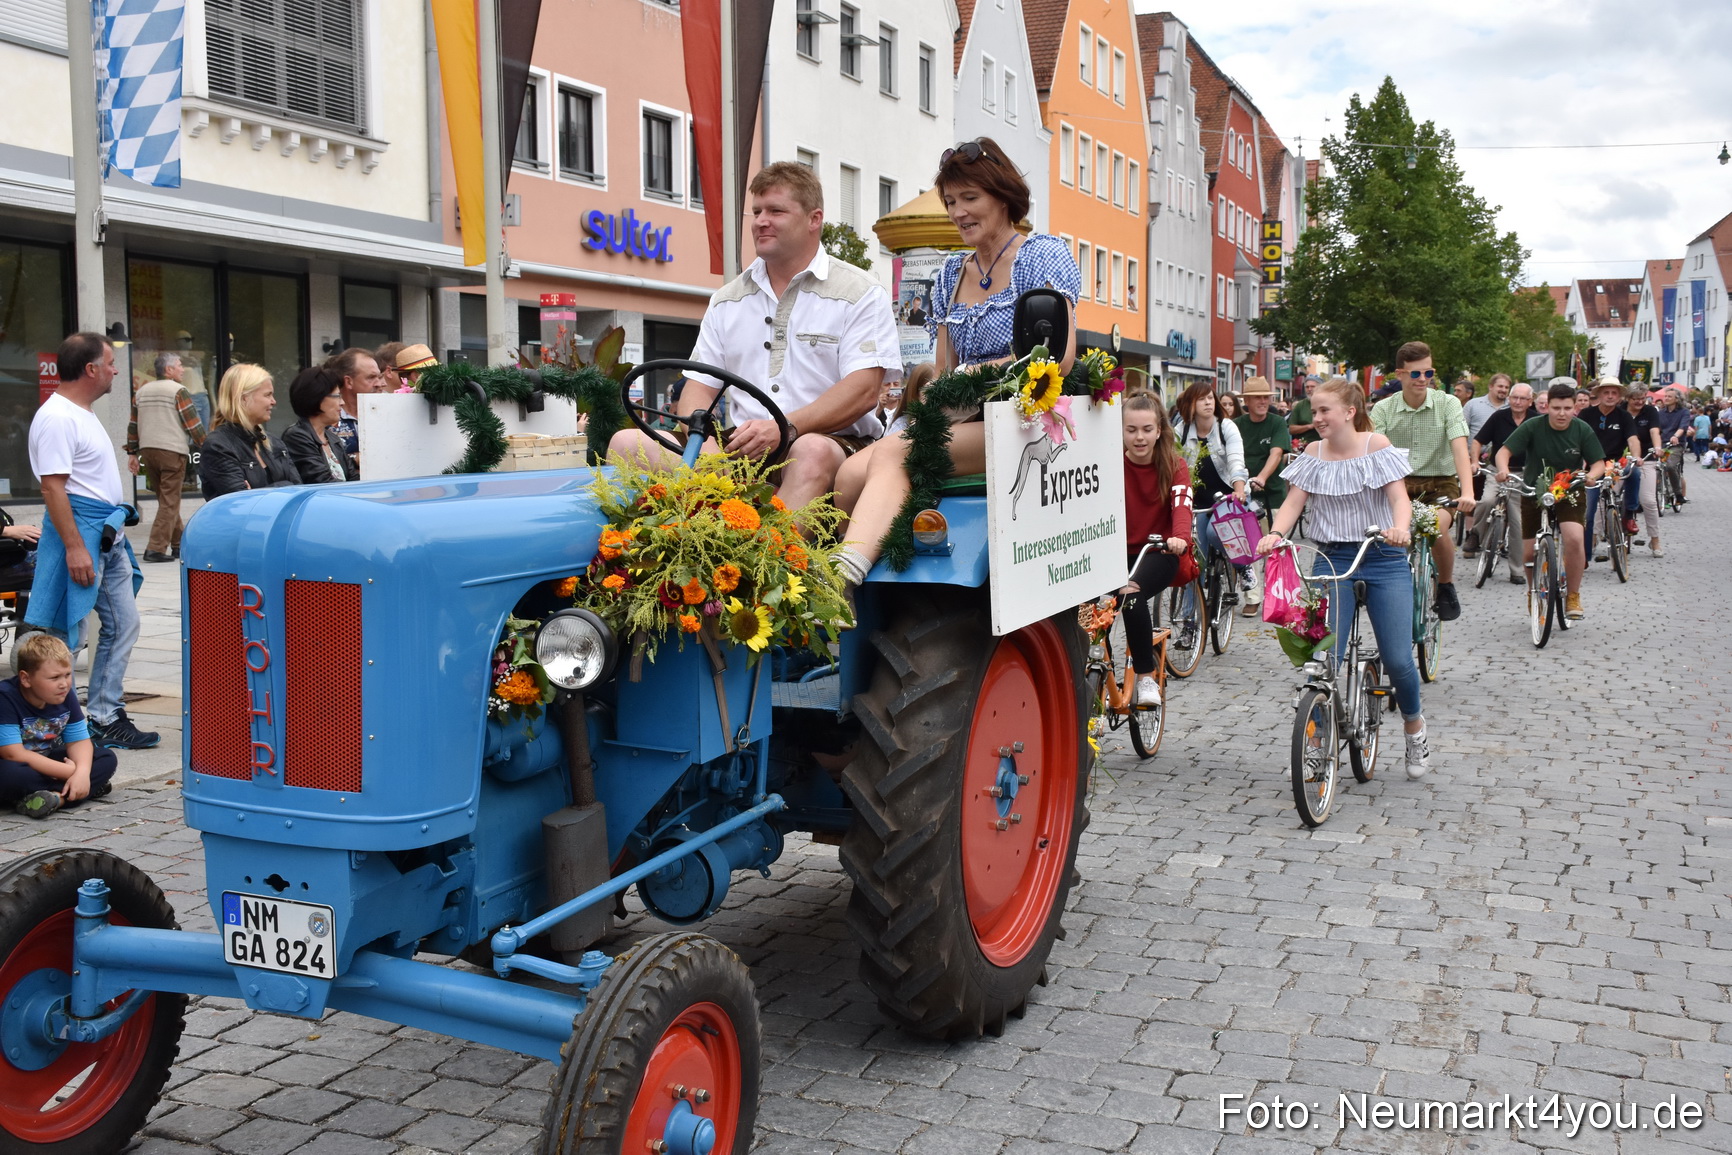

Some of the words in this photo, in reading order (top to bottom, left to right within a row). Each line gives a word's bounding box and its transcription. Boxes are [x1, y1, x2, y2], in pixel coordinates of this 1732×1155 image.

[905, 258, 945, 268] SEBASTIANREIC
[1263, 223, 1281, 316] HOTE
[132, 283, 162, 299] SALE
[132, 304, 163, 320] SALE
[900, 343, 925, 351] ELSENFEST
[1040, 463, 1100, 514] Express
[1012, 514, 1116, 565] Interessengemeinschaft
[1047, 553, 1092, 586] Neumarkt
[229, 913, 237, 923] D
[243, 899, 279, 934] NM
[231, 931, 266, 964] GA
[275, 937, 326, 974] 824
